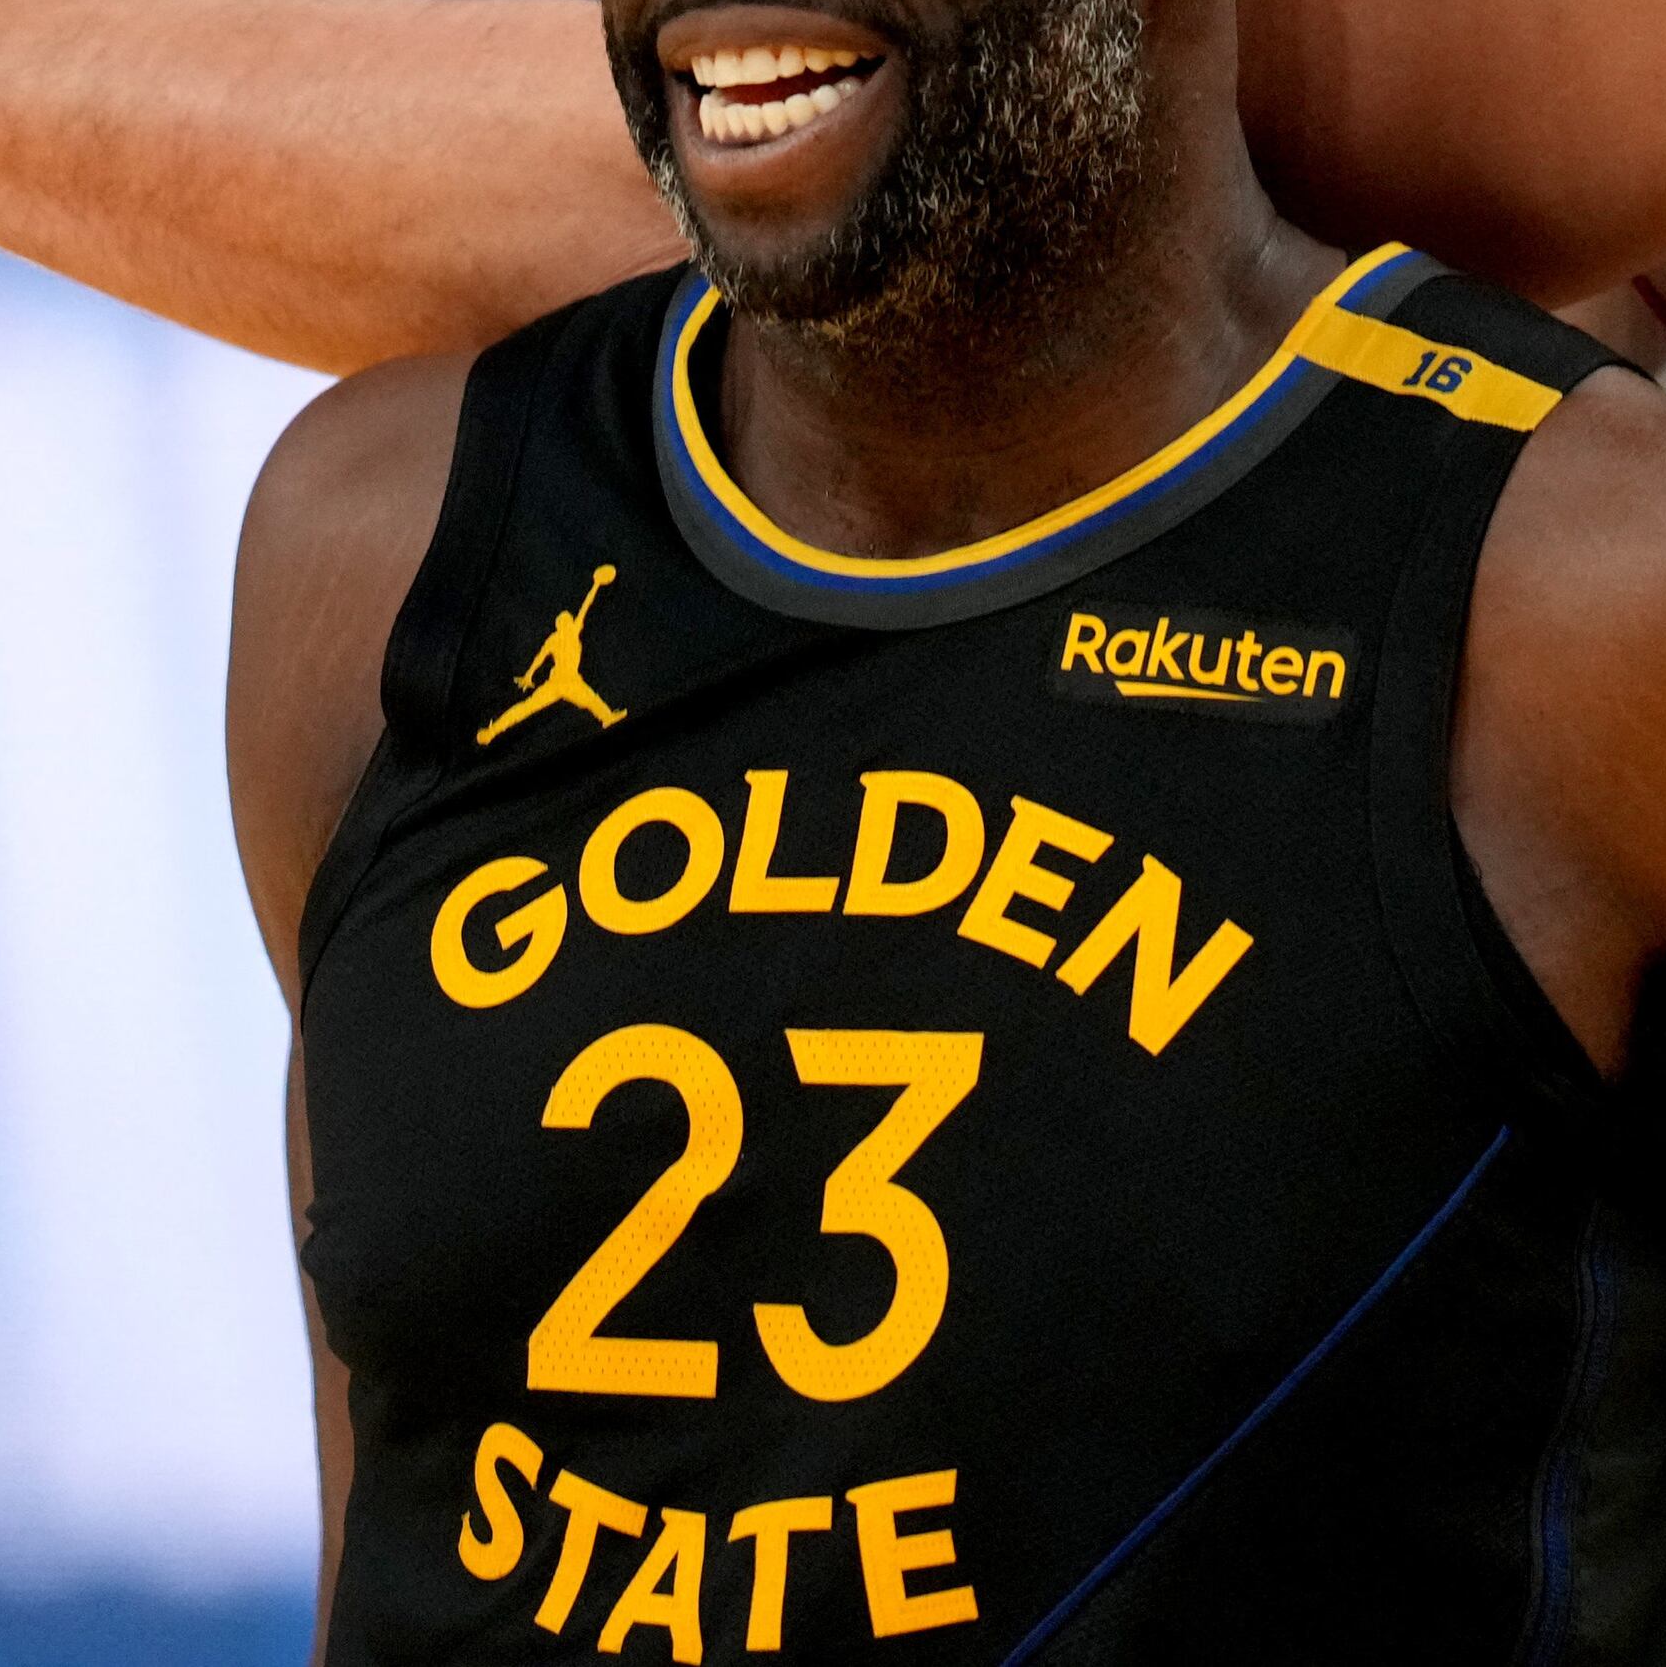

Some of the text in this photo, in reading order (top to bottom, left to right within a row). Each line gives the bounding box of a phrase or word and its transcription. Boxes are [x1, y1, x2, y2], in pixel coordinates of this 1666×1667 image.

[1402, 350, 1473, 393] 16
[1060, 612, 1346, 699] Rakuten
[429, 768, 1255, 1057] GOLDEN
[525, 1022, 986, 1403] 23
[457, 1421, 980, 1667] STATE
